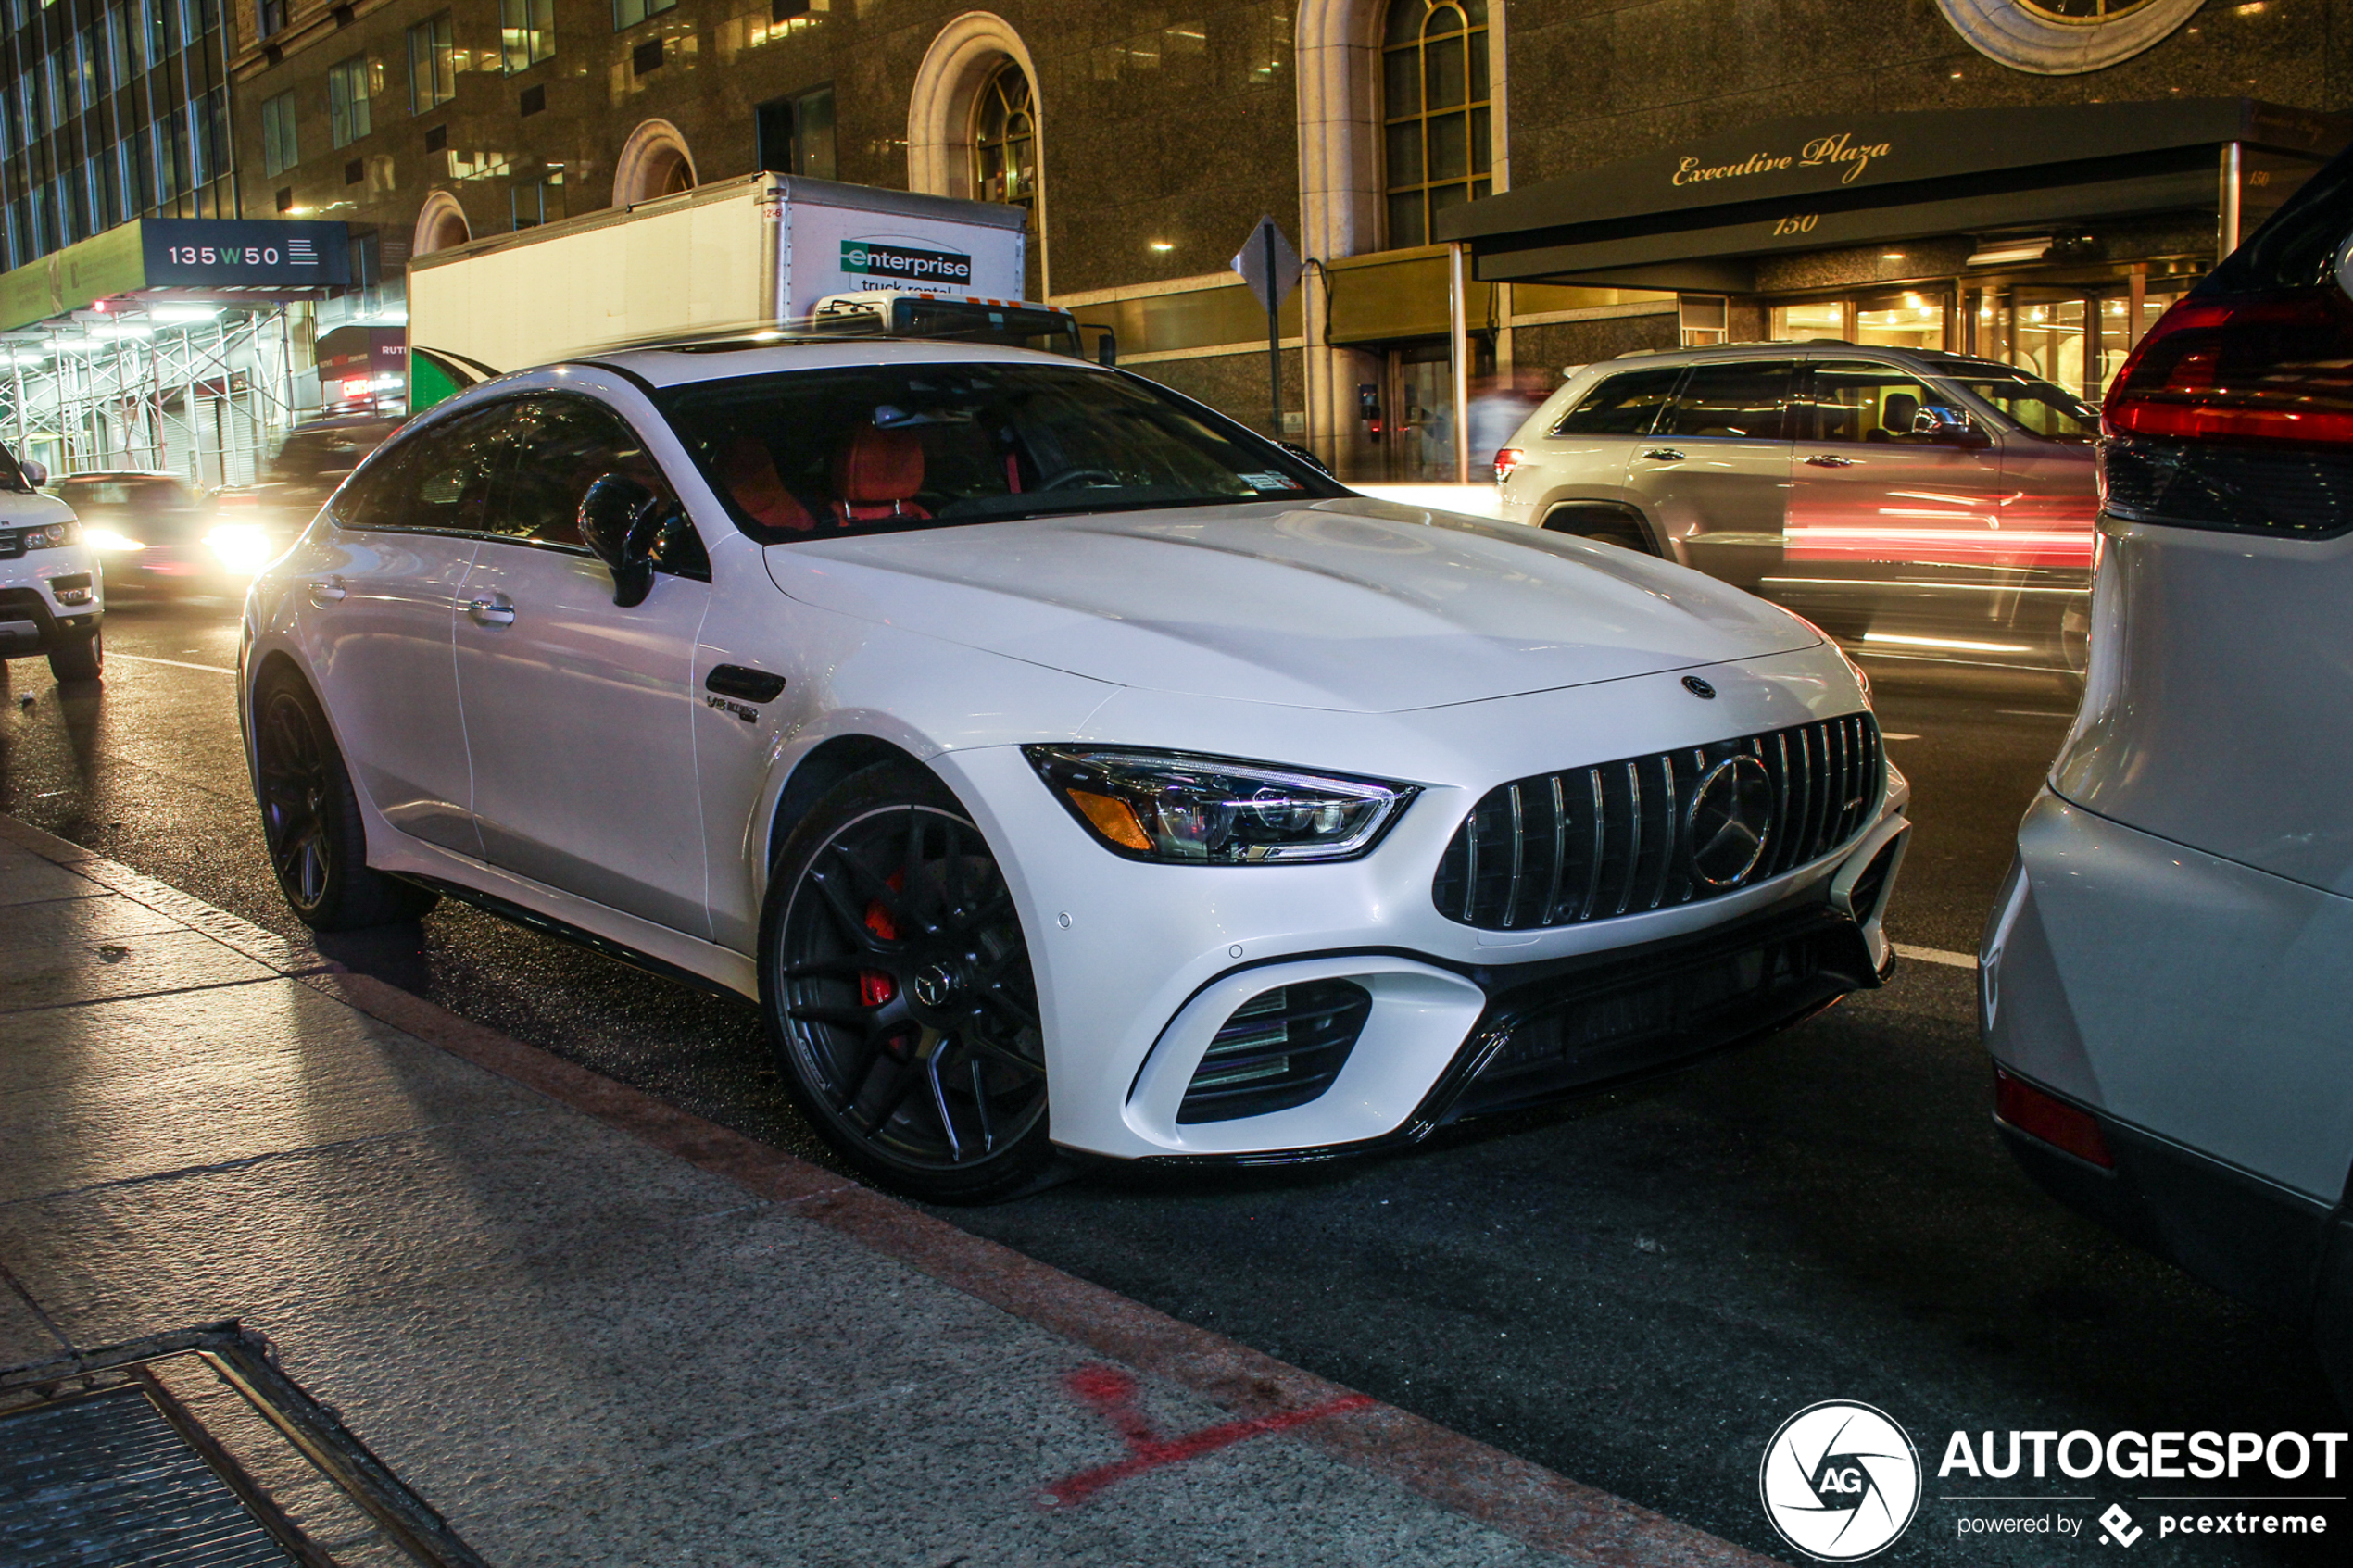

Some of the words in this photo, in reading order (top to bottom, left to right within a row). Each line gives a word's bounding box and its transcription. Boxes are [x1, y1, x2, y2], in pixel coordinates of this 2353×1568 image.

[1672, 152, 1793, 186] Executive
[1798, 132, 1892, 184] Plaza
[2248, 170, 2270, 187] 150
[1772, 212, 1818, 236] 150
[169, 246, 279, 265] 135W50
[843, 249, 969, 277] enterprise
[862, 280, 902, 291] truck
